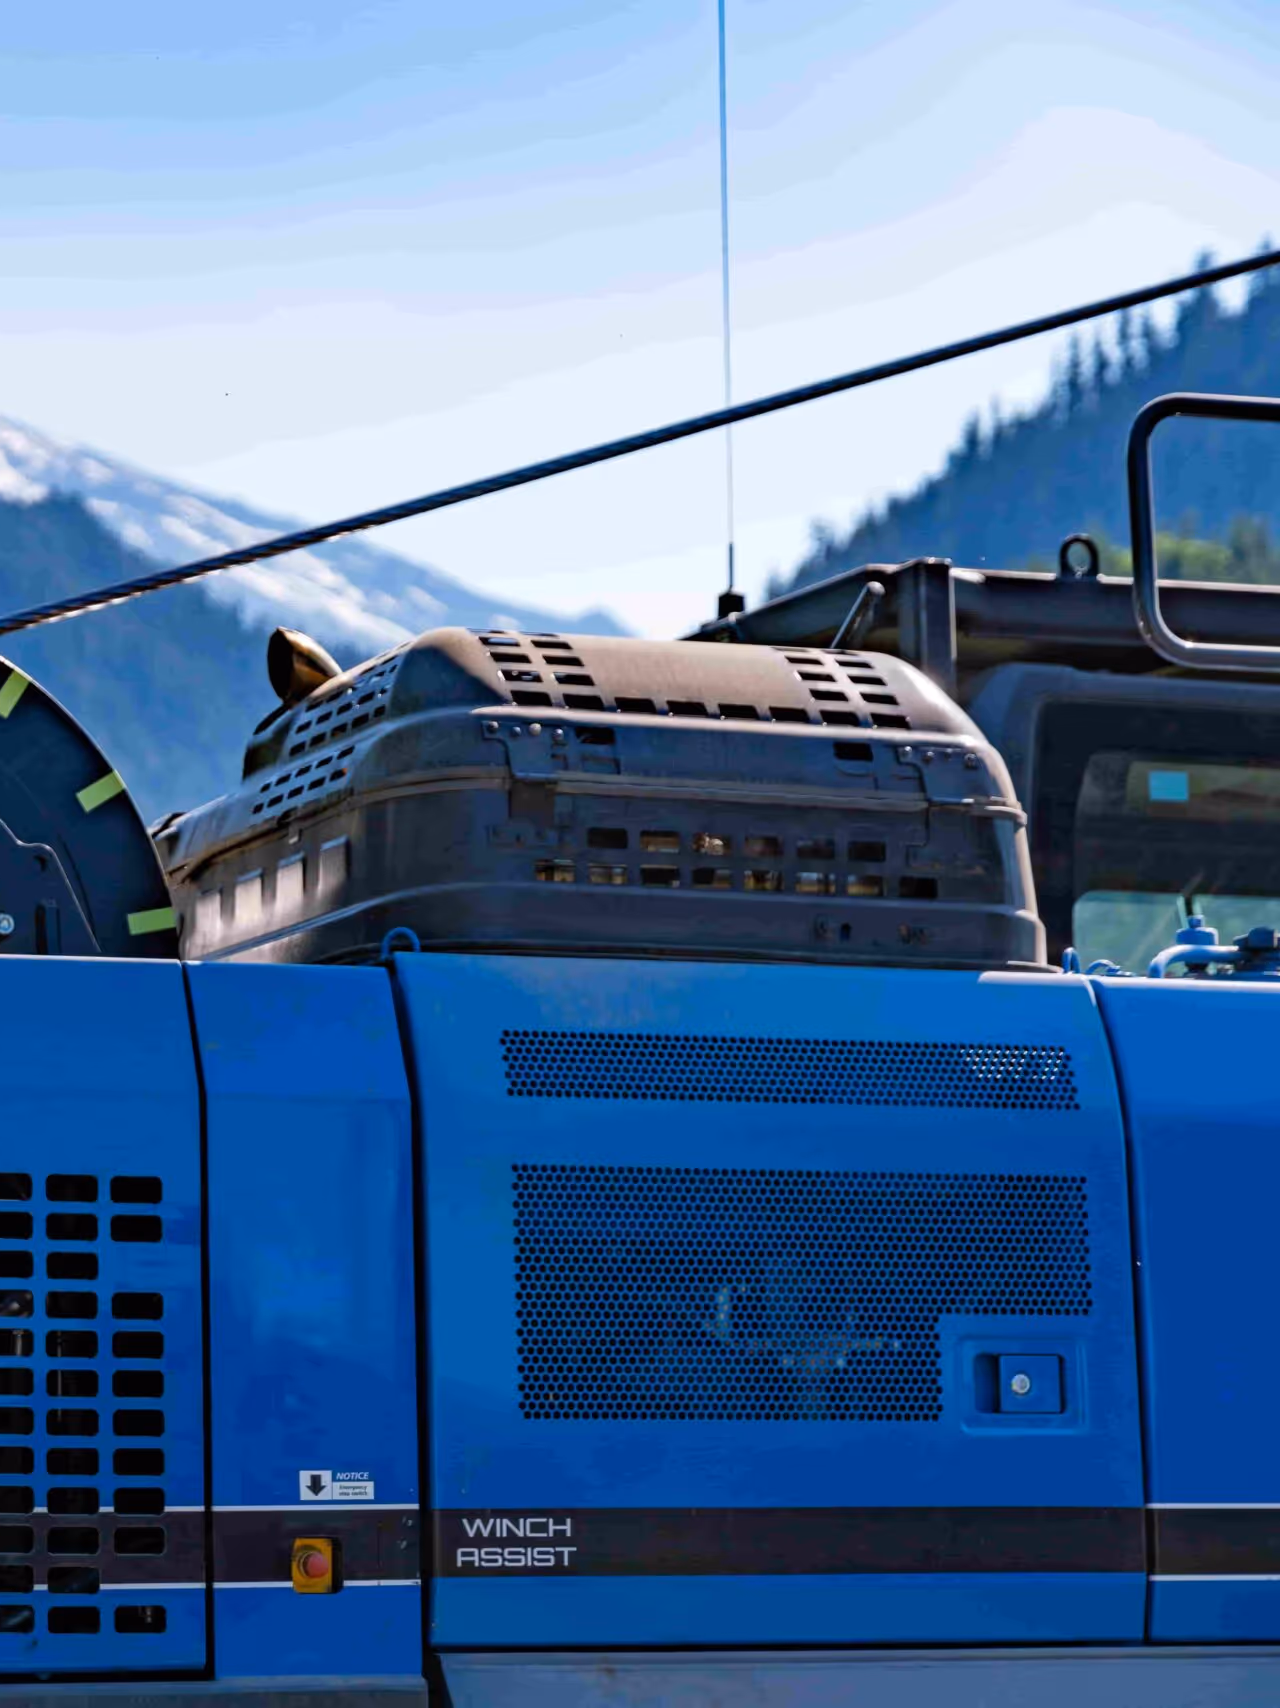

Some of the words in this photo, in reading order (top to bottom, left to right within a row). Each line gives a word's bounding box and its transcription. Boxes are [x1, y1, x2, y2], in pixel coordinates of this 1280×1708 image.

[336, 1472, 369, 1480] NOTICE
[462, 1518, 571, 1537] WINCH
[457, 1547, 577, 1568] ASSIST
